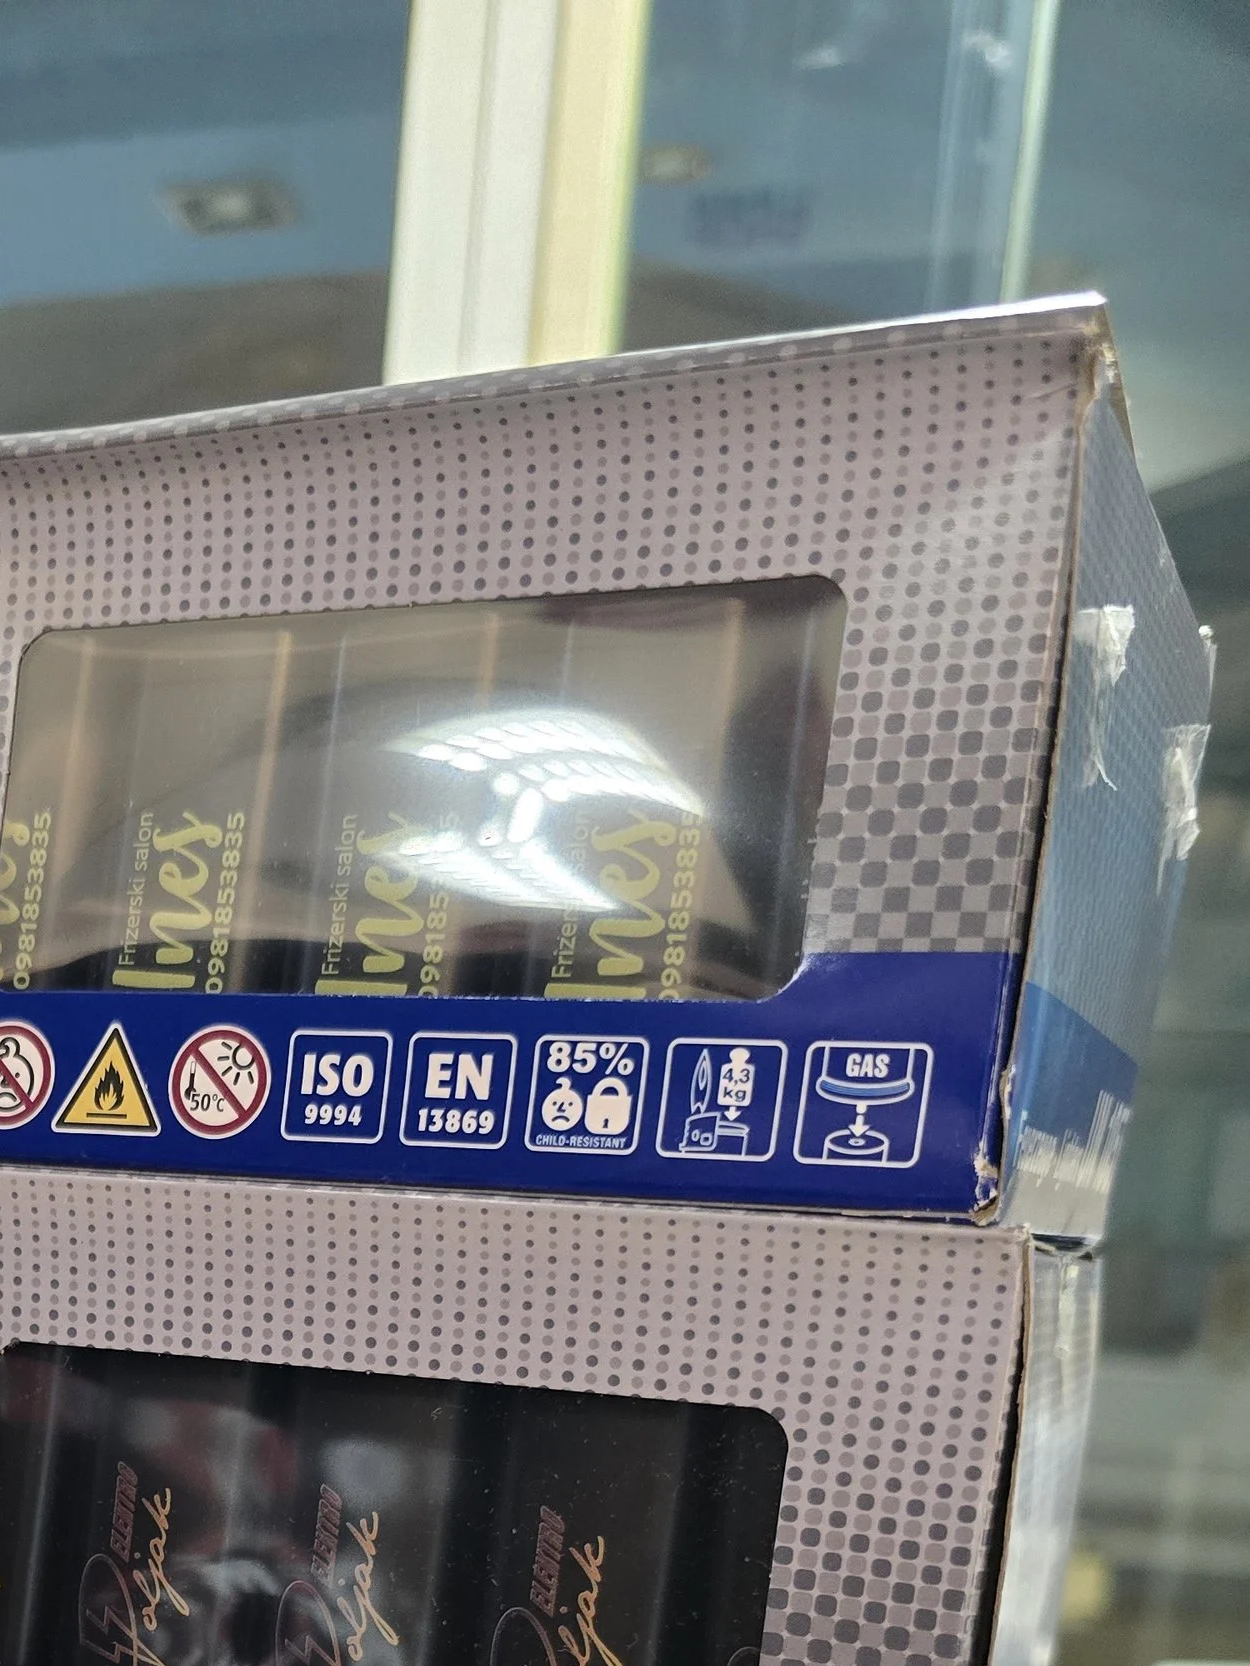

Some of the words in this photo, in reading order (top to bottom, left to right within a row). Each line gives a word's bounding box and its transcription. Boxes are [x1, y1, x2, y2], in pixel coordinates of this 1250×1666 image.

[334, 813, 358, 877] salon
[13, 811, 51, 990] 0981853835
[118, 878, 146, 966] Frizerski
[132, 813, 154, 872] salon
[205, 811, 245, 995] 0981853835
[321, 881, 349, 975] Frizerski
[300, 1053, 374, 1098] ISO
[425, 1052, 494, 1101] EN
[547, 1041, 634, 1077] 85%
[722, 1067, 751, 1087] 4,3
[846, 1053, 890, 1079] GAS
[722, 1086, 748, 1104] kg
[303, 1104, 363, 1128] 9994
[417, 1108, 495, 1136] 13869
[535, 1134, 626, 1150] CHILD-RESISTANT
